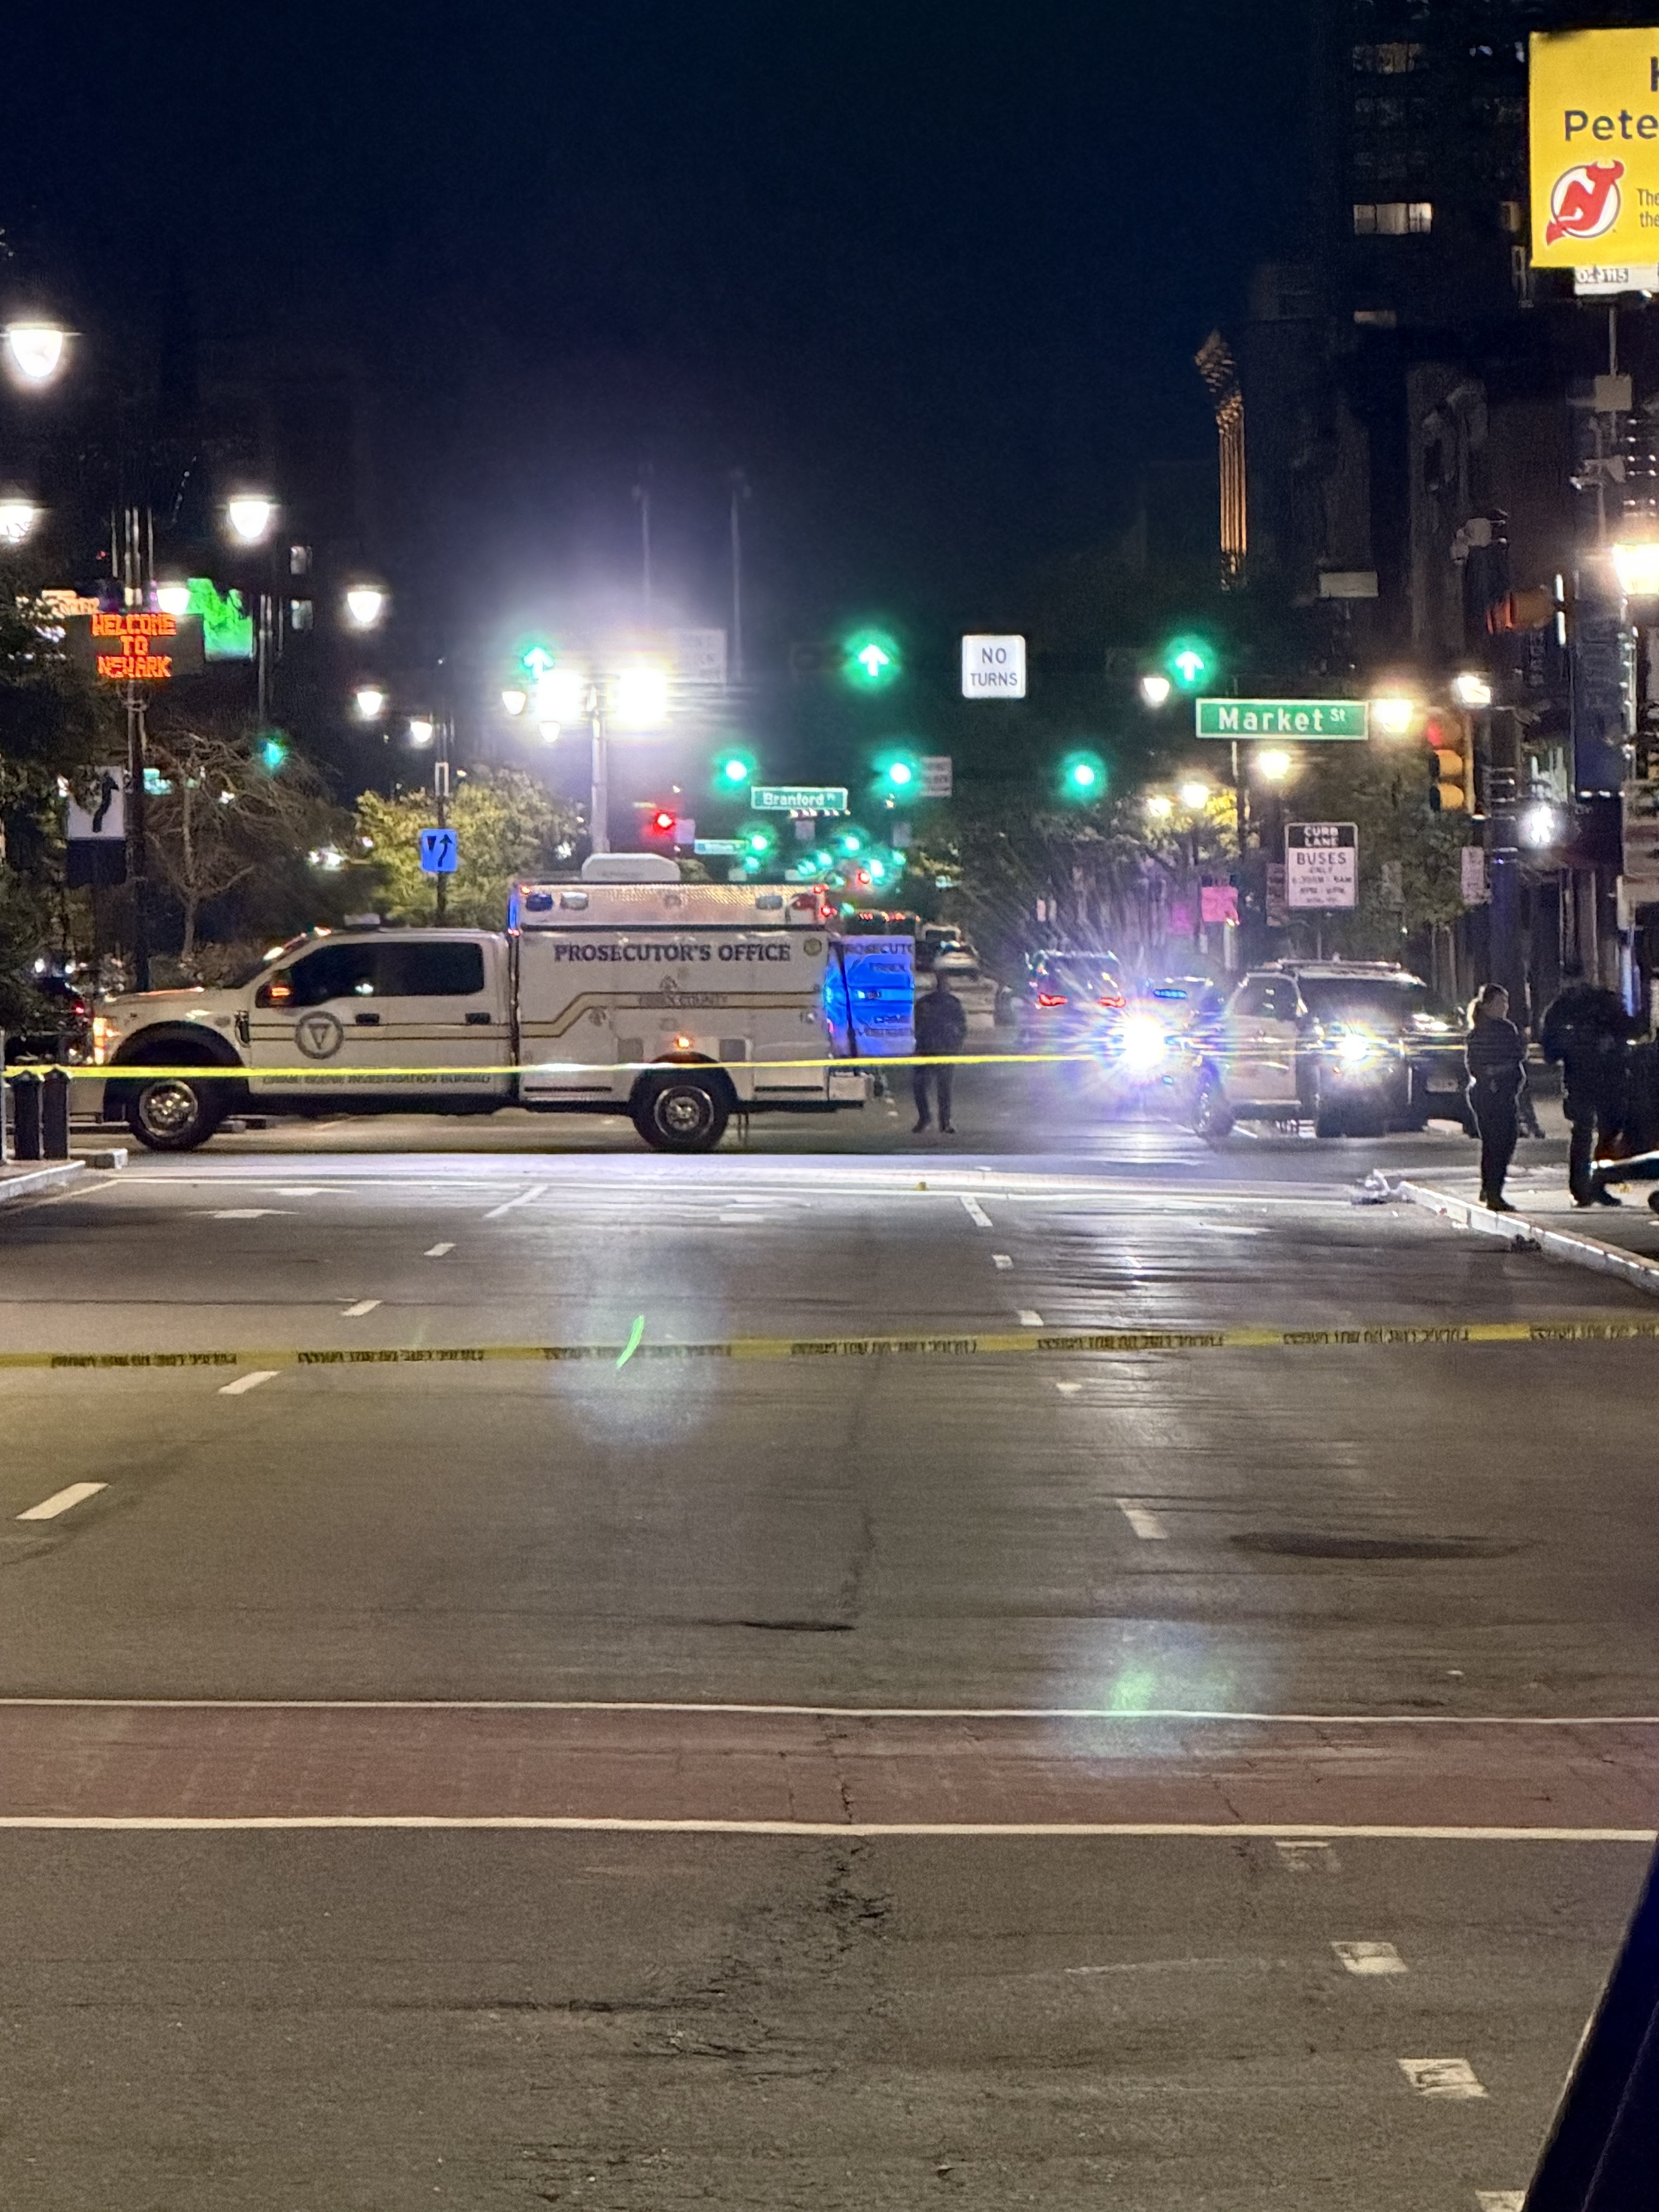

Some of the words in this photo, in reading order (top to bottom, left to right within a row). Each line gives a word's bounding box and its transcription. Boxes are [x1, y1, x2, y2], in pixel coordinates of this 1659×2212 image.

[1565, 109, 1659, 141] Pete
[92, 614, 177, 636] WELCOME
[119, 636, 149, 656] TO
[982, 647, 1007, 664] NO
[96, 656, 173, 678] NEWARK
[970, 672, 1018, 687] TURNS
[1218, 707, 1324, 732] Market
[1329, 708, 1346, 722] St
[763, 792, 824, 806] Branford
[1304, 826, 1339, 837] CURB
[1304, 837, 1339, 847] LANE
[1297, 852, 1347, 866] BUSES
[554, 943, 711, 962] PROSECUTOR'S
[718, 944, 791, 962] OFFICE
